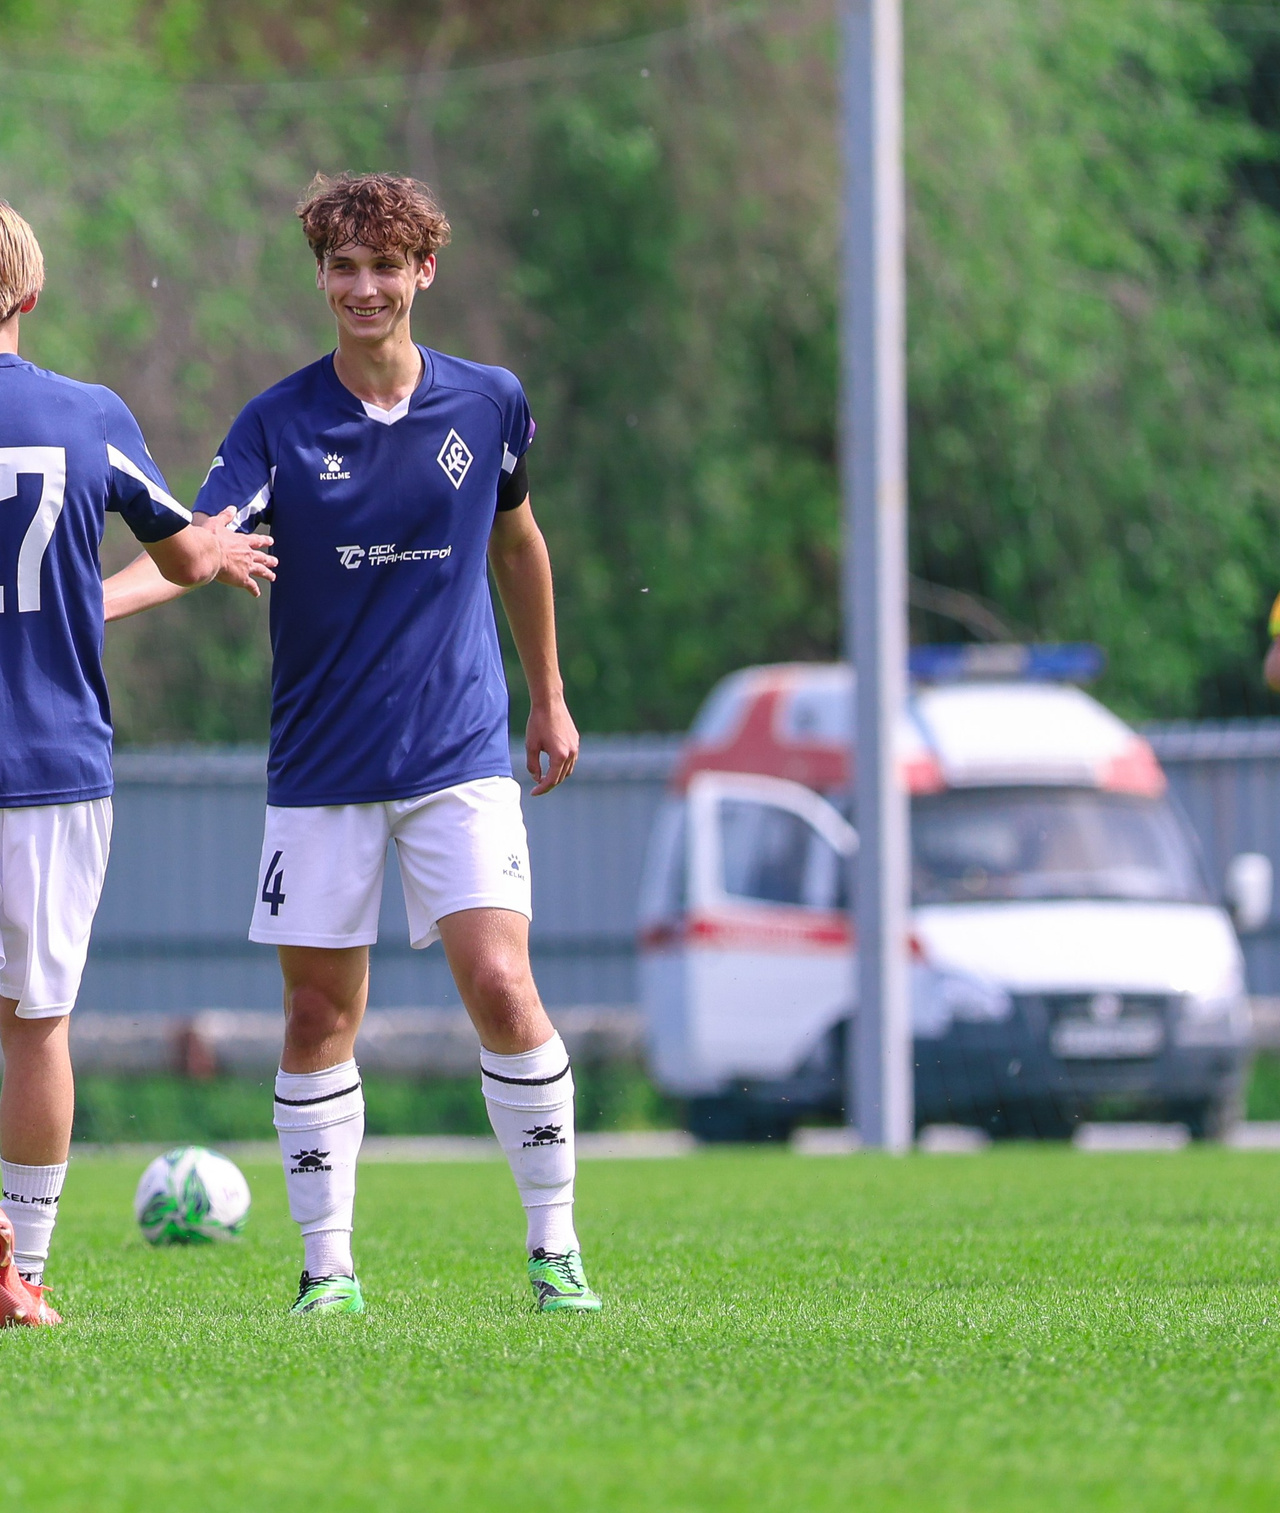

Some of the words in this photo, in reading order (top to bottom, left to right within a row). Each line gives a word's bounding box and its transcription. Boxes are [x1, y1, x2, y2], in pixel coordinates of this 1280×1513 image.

[320, 472, 351, 481] KELME
[369, 543, 396, 556] ДСК
[261, 849, 286, 916] 4
[523, 1137, 566, 1149] KELME
[290, 1165, 332, 1175] KELME
[4, 1189, 53, 1205] KELME
